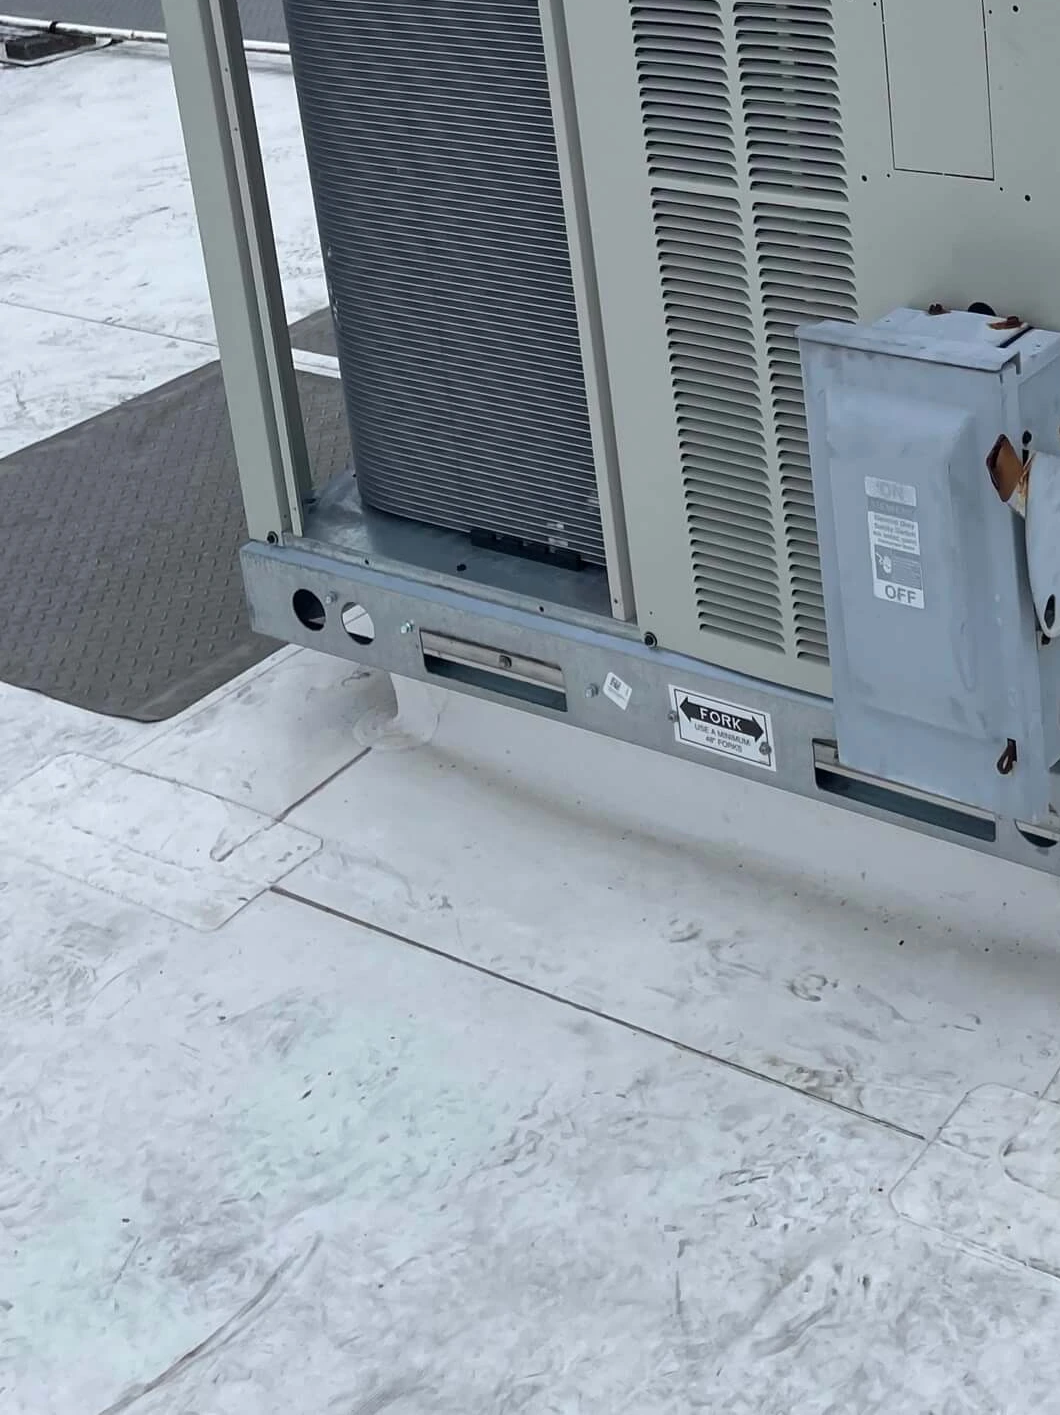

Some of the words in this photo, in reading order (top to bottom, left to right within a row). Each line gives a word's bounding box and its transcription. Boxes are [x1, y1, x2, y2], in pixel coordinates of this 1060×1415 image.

[885, 585, 916, 604] OFF
[700, 707, 742, 731] FORK
[694, 723, 709, 734] USE
[717, 729, 751, 746] MINIMUM
[717, 738, 743, 753] FORKS
